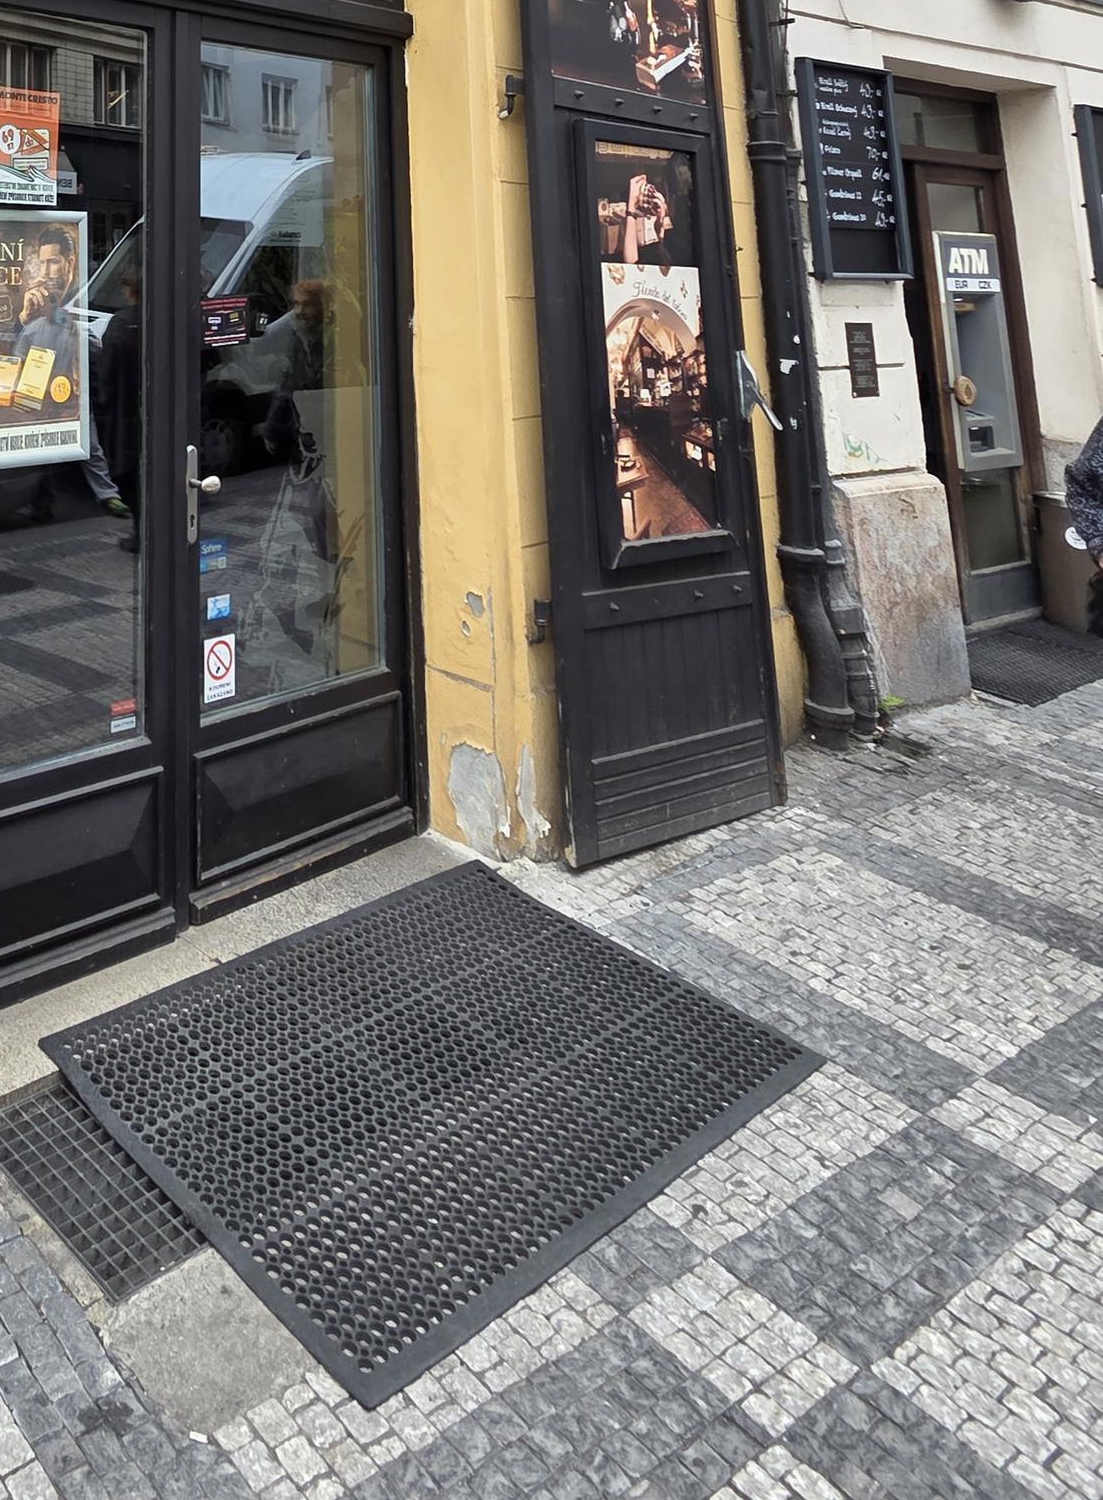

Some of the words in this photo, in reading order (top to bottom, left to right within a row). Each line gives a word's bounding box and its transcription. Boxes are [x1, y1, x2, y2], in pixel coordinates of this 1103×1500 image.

[1, 128, 15, 144] 69
[948, 247, 989, 275] ATM
[955, 280, 968, 289] EUR
[979, 281, 992, 289] CZK
